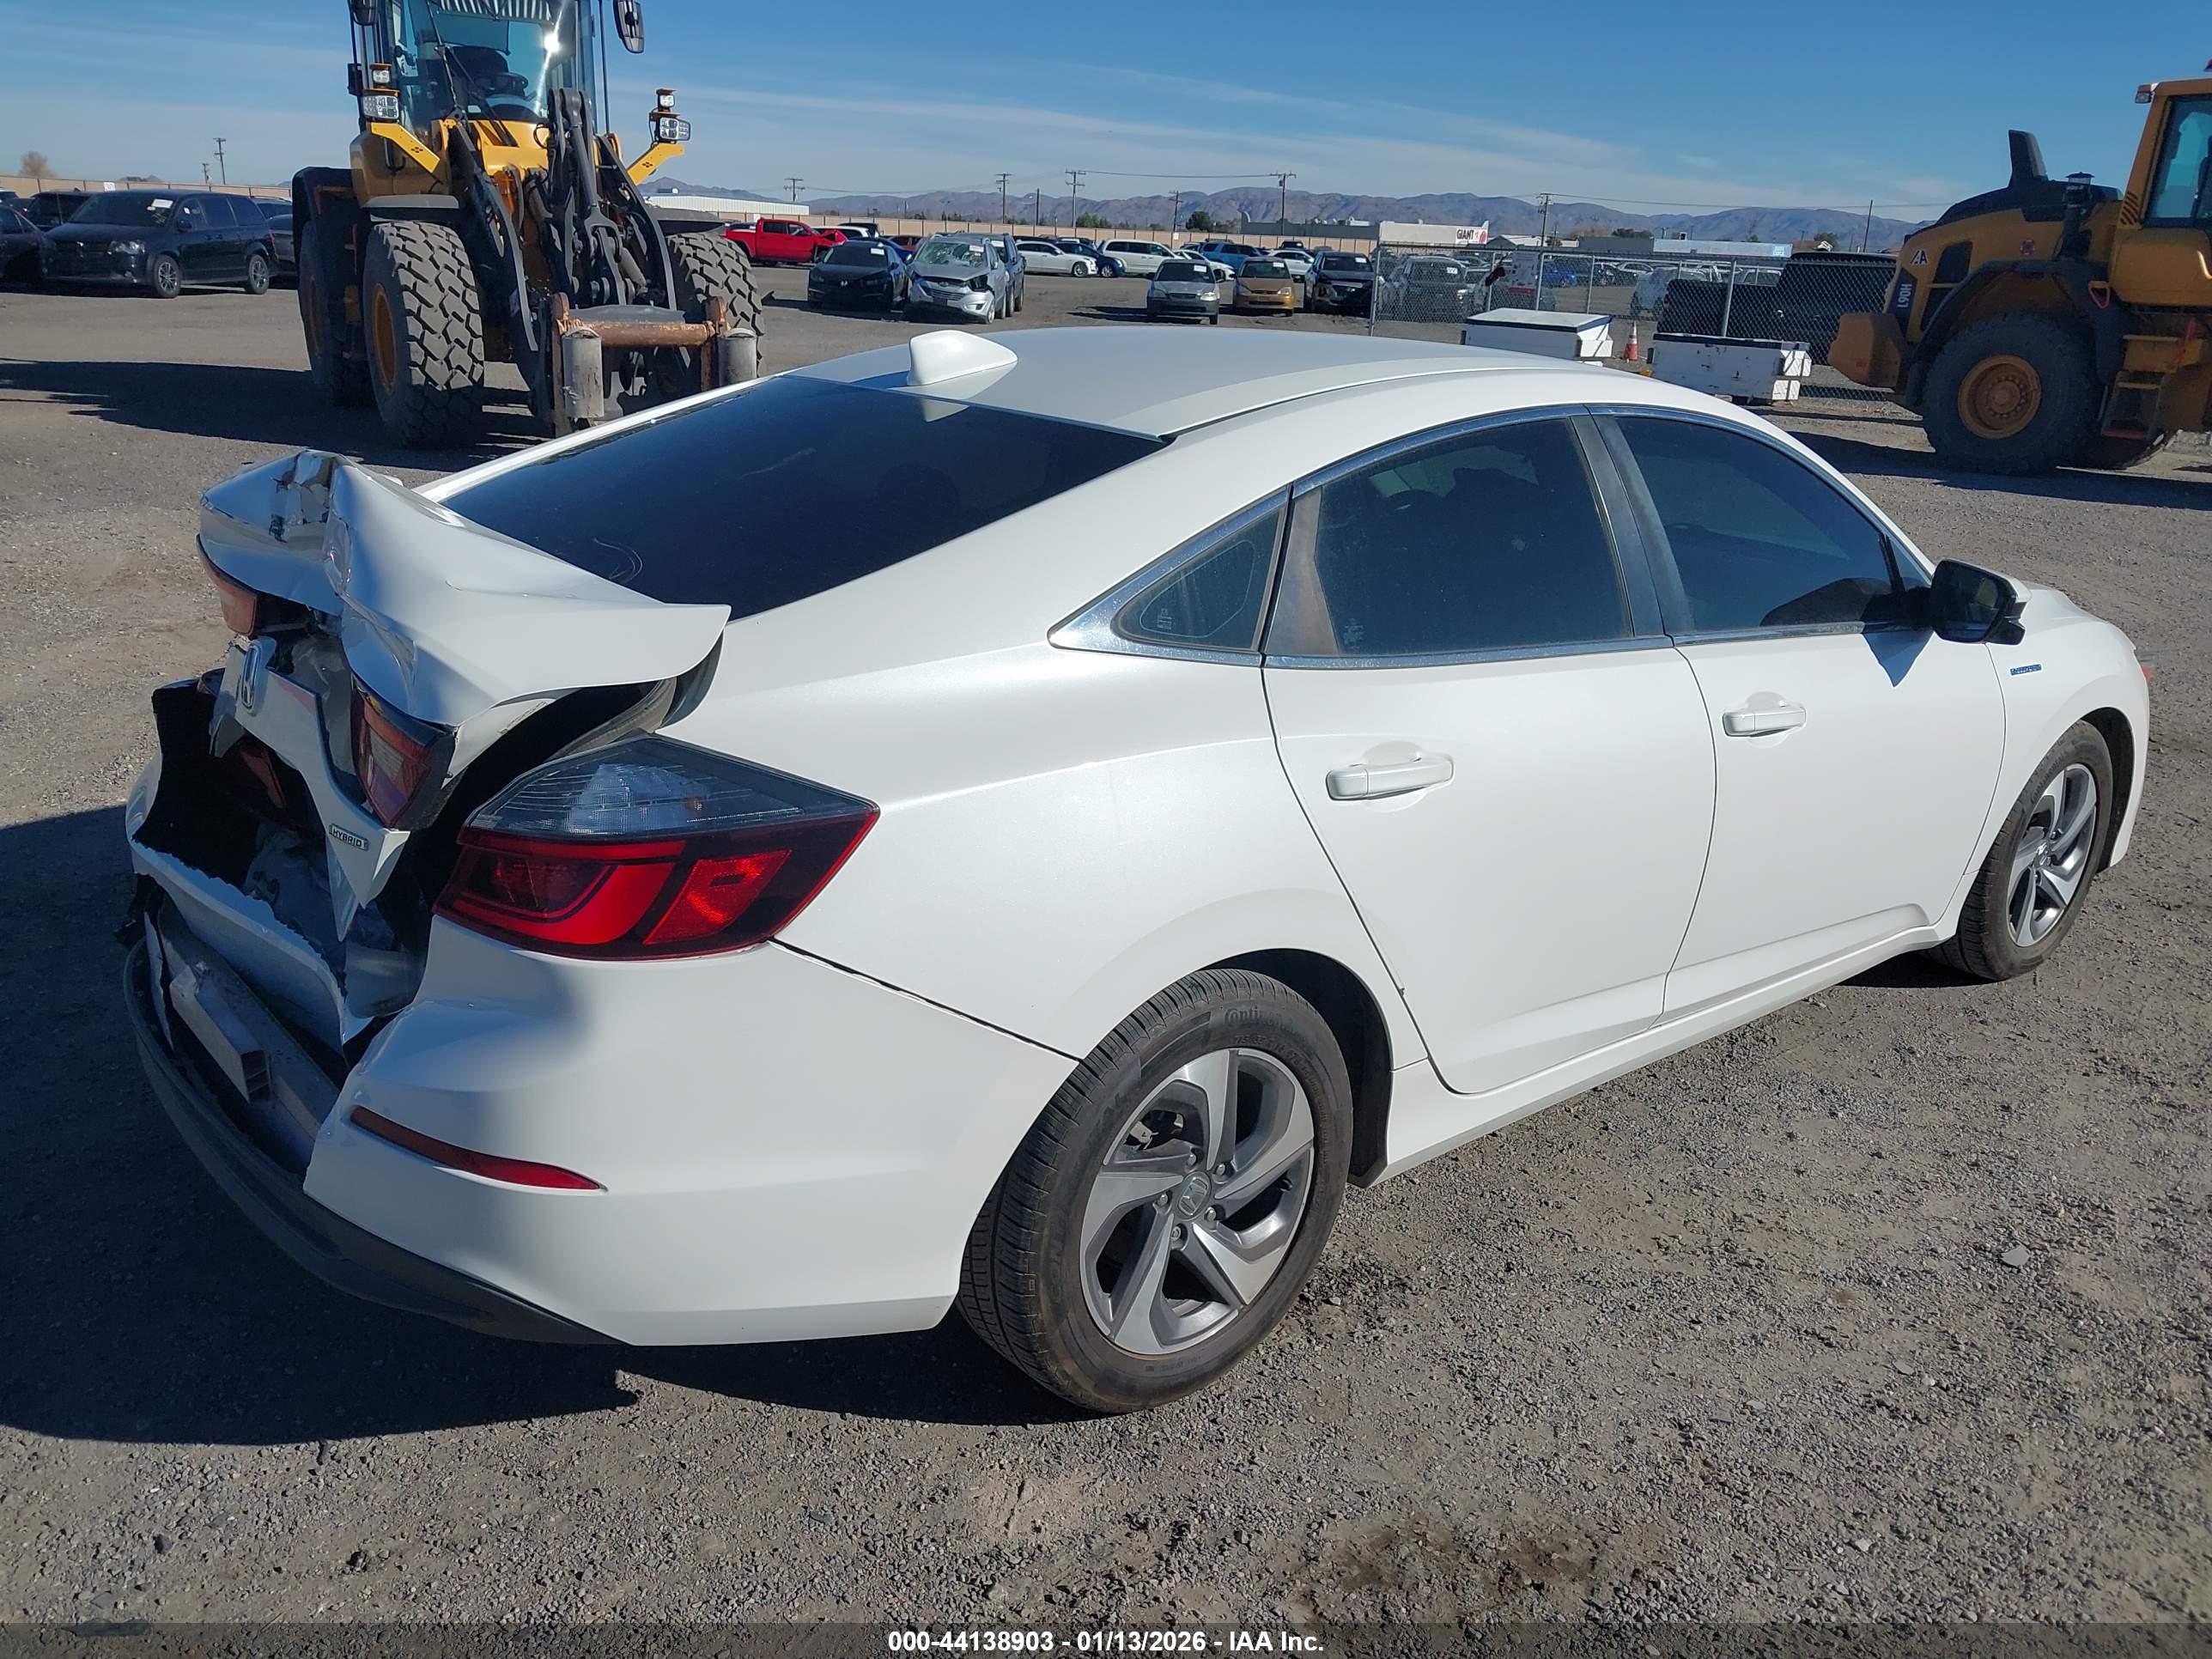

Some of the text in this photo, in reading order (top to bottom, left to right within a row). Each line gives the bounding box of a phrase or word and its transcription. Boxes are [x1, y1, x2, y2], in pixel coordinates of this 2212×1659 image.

[1457, 229, 1474, 240] GIANT
[1897, 283, 1913, 308] L90H
[332, 826, 362, 848] HYBRID
